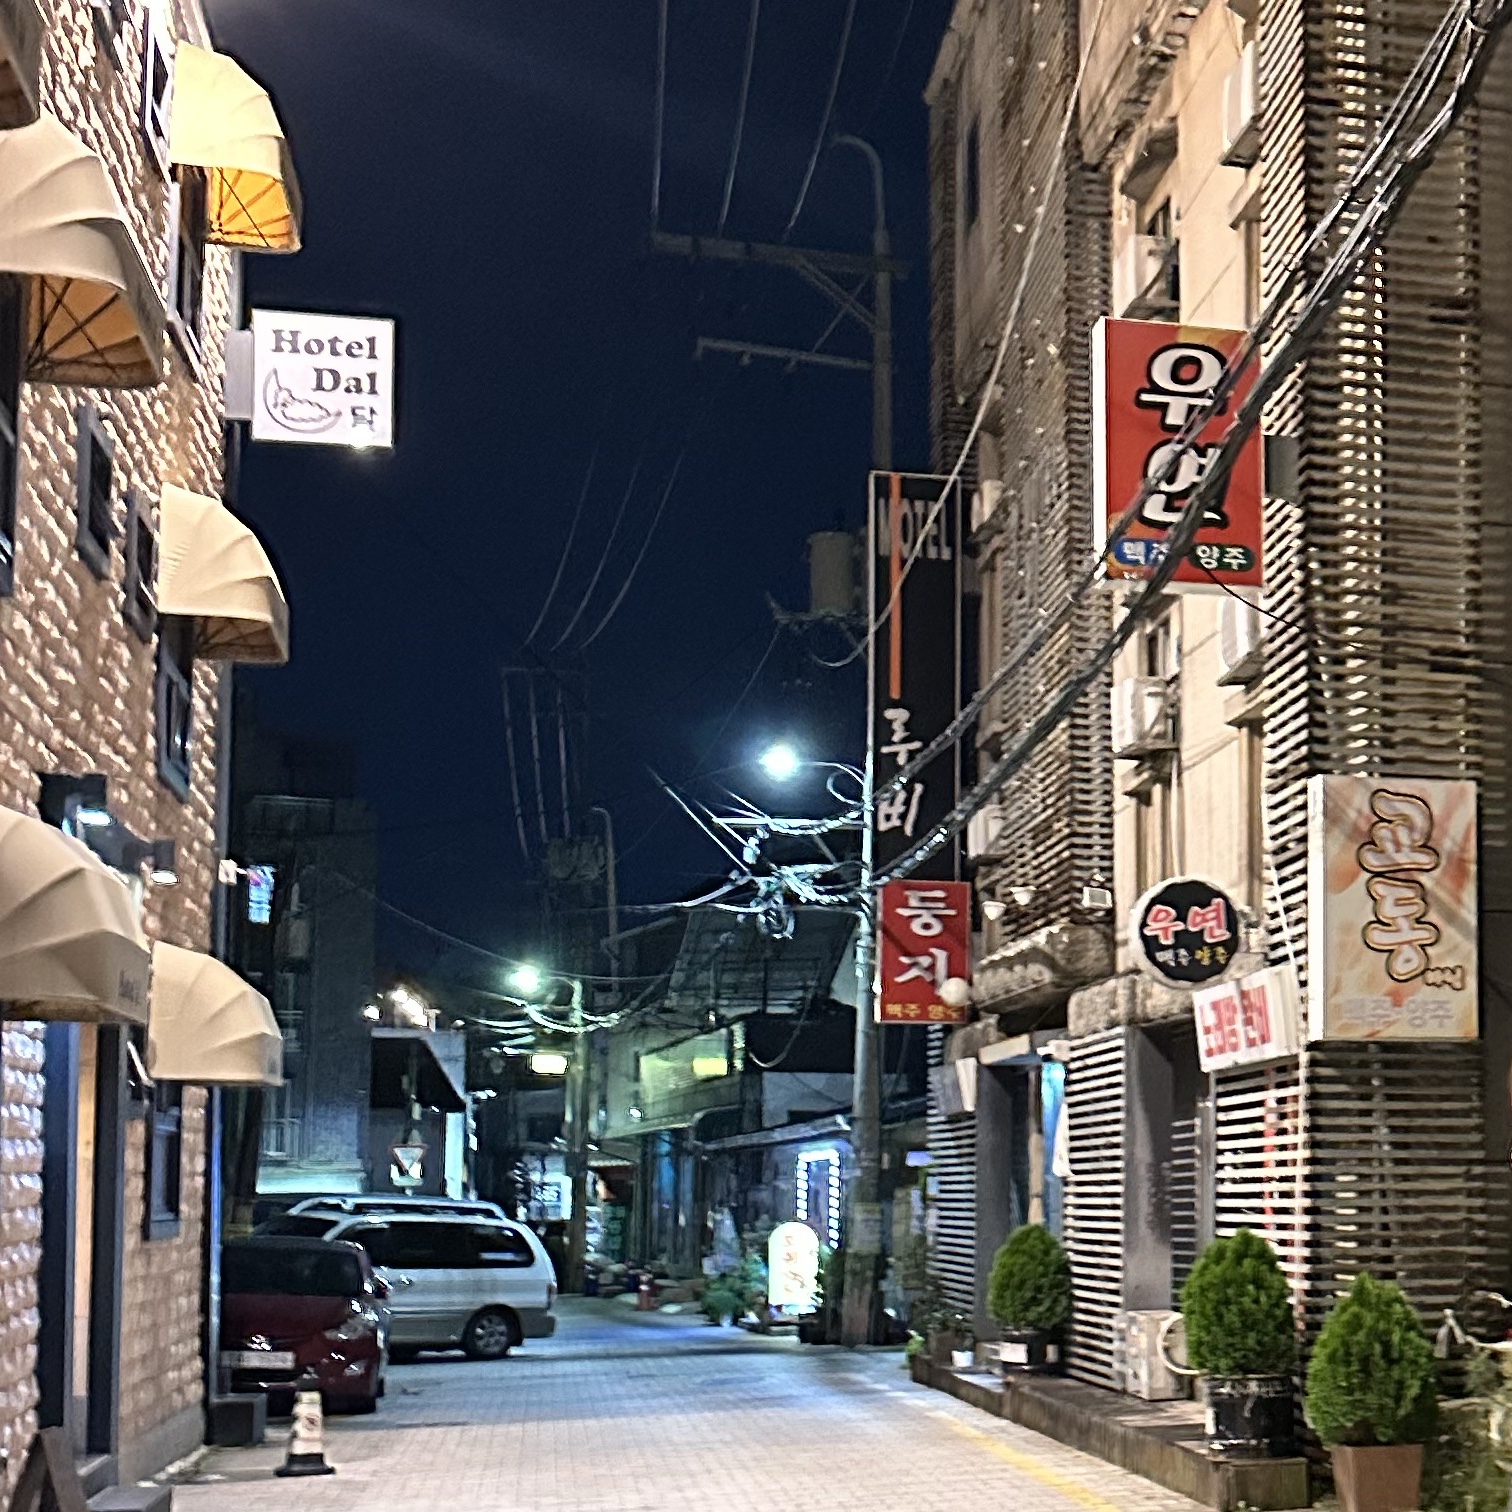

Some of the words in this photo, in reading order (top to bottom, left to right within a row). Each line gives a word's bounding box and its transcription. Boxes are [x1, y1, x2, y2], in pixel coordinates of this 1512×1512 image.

[271, 328, 379, 360] Hotel
[311, 366, 379, 396] Dal
[1136, 342, 1229, 530] 우연
[1195, 544, 1248, 571] 양주
[876, 707, 925, 838] 루비
[894, 889, 958, 996] 둥지
[1143, 897, 1232, 945] 우연
